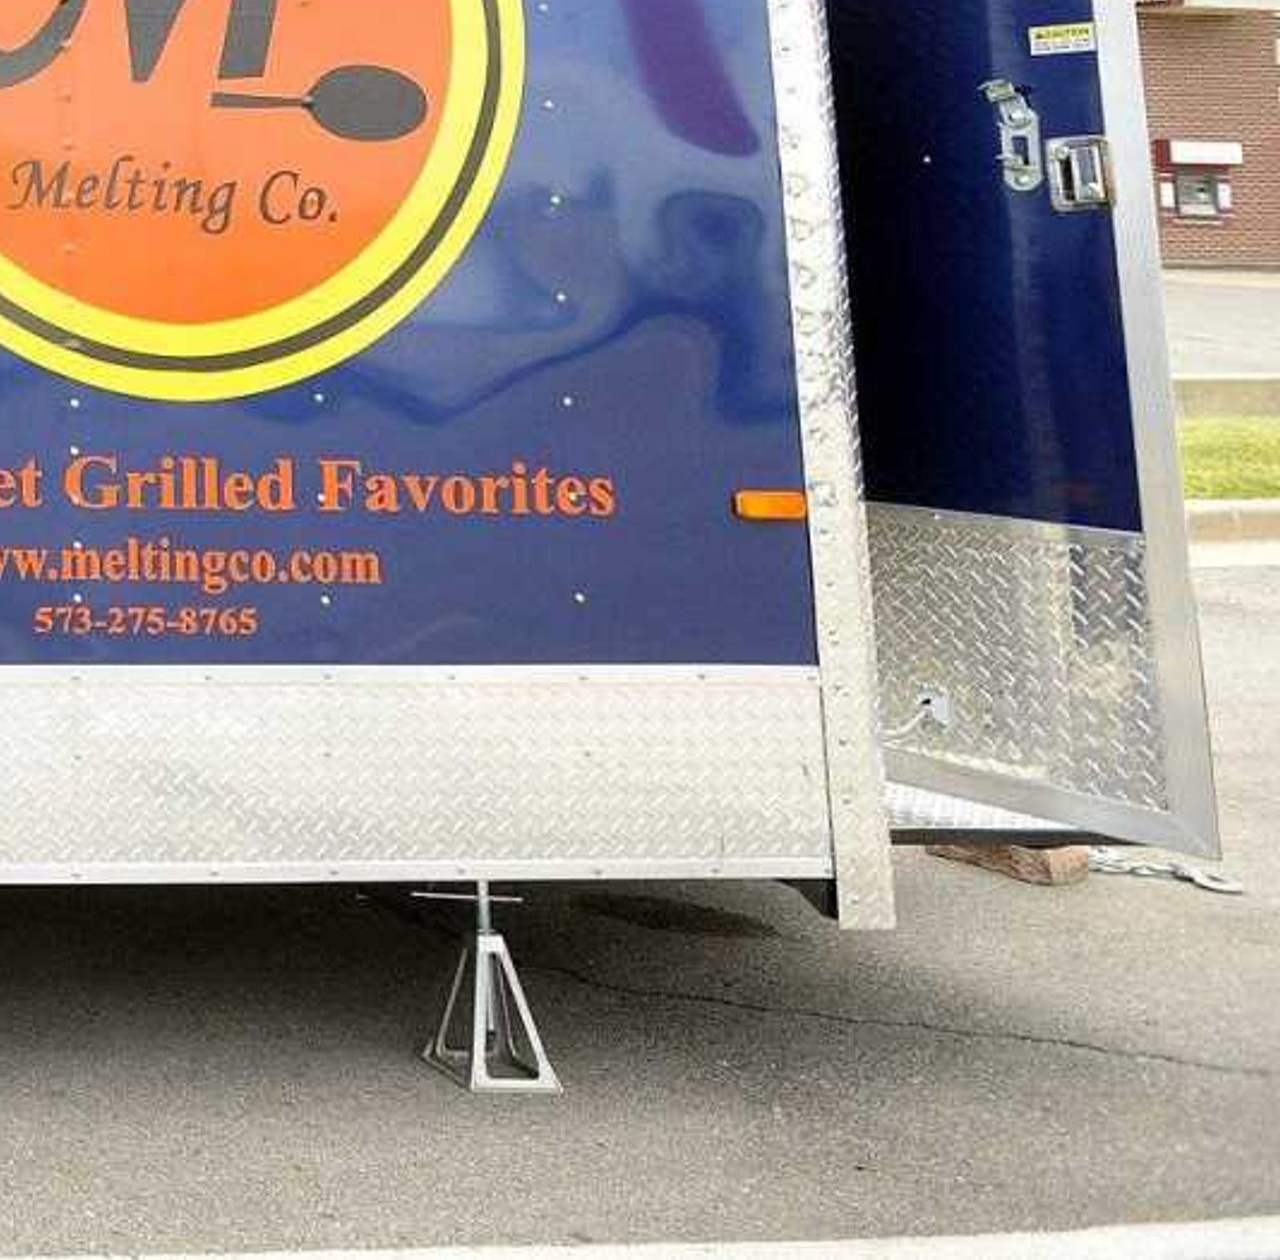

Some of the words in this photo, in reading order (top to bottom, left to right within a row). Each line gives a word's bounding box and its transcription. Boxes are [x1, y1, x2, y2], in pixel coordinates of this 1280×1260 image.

[5, 155, 237, 234] Melting
[259, 170, 338, 225] Co.
[63, 455, 294, 511] Grilled
[318, 459, 617, 516] Favorites
[34, 607, 259, 635] 573-275-8765
